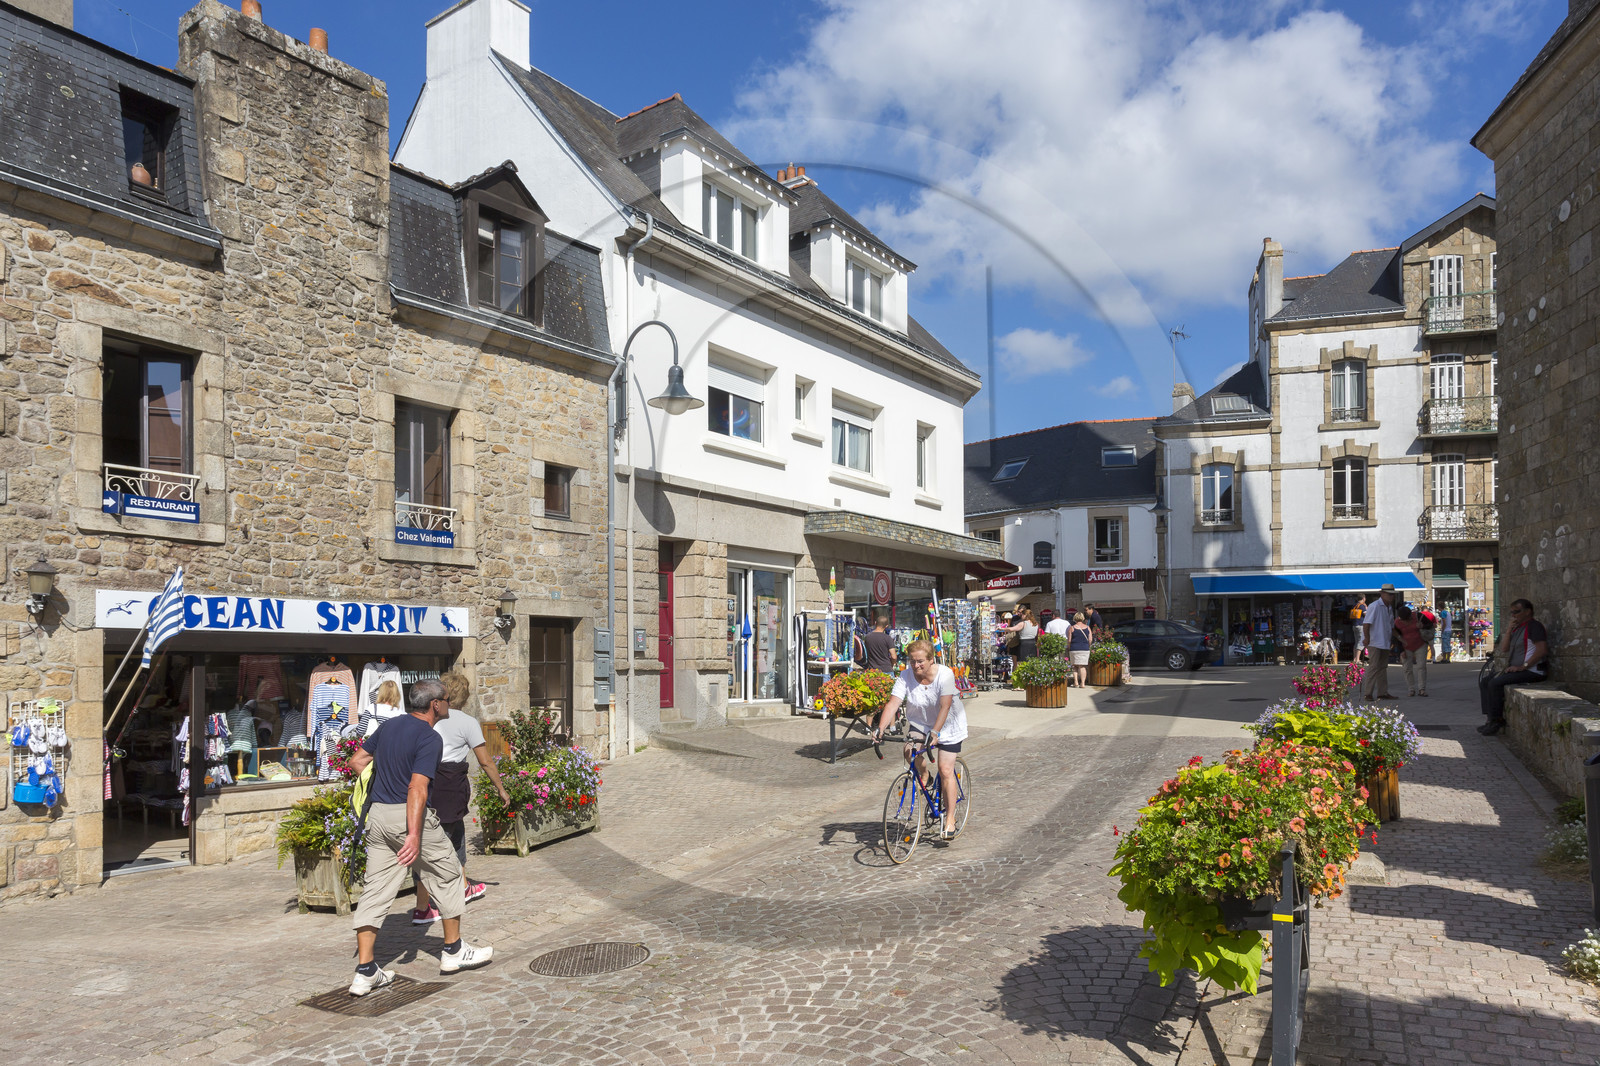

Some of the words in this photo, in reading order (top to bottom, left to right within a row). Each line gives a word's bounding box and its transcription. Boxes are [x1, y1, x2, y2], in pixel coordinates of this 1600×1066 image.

[130, 497, 196, 512] RESTAURANT
[397, 531, 418, 541] Chez
[419, 532, 452, 544] Valentin
[986, 576, 1021, 588] Ambryzel
[1087, 570, 1135, 582] Ambryzel
[316, 601, 428, 634] SPIRIT
